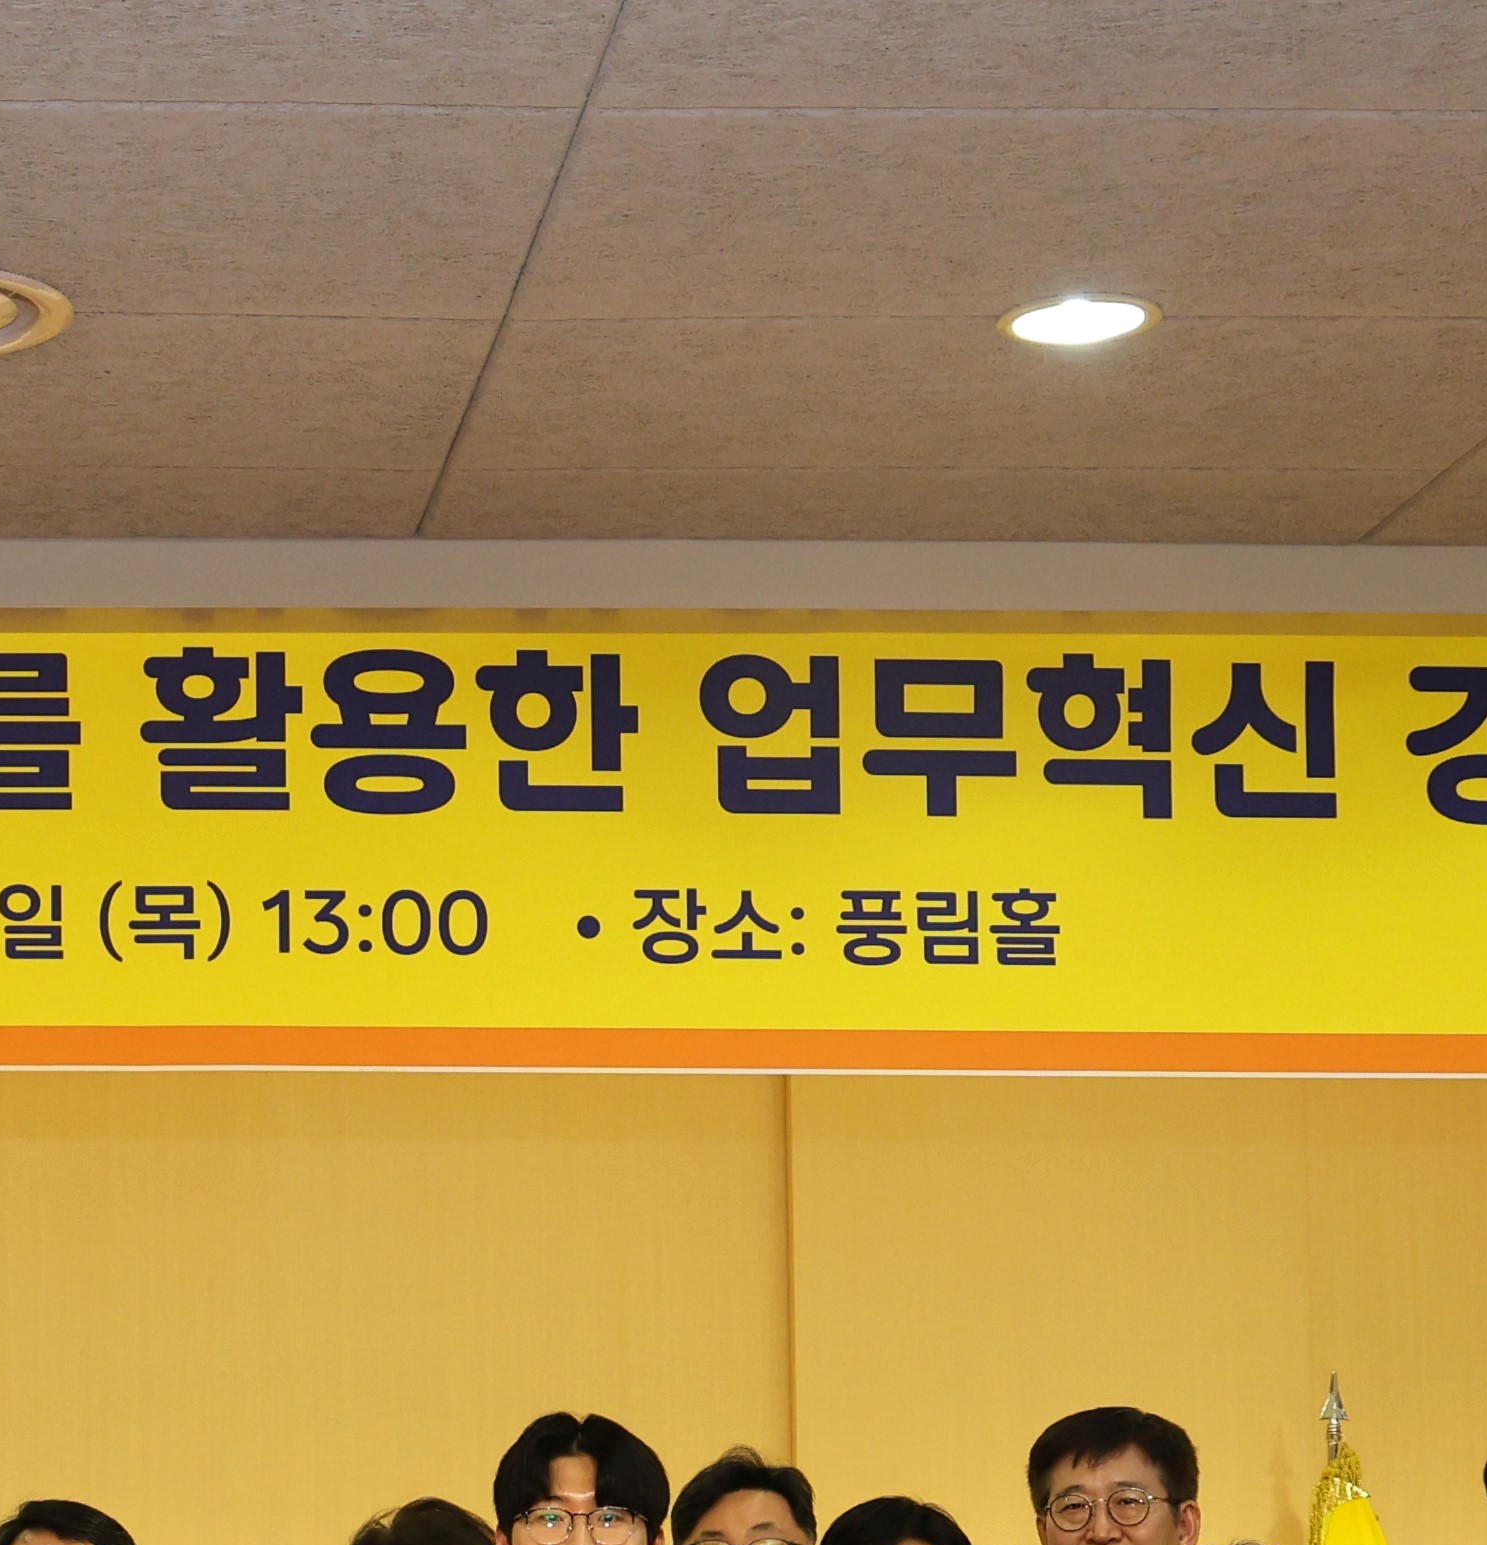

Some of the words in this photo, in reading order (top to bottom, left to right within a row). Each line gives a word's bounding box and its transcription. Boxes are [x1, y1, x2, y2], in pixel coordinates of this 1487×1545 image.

[140, 647, 638, 814] 활용한
[700, 654, 1343, 819] 업무혁신
[100, 881, 230, 962] (목)
[263, 890, 487, 955] 13:00
[633, 882, 804, 964] 장소:
[836, 882, 1060, 965] 풍림홀
